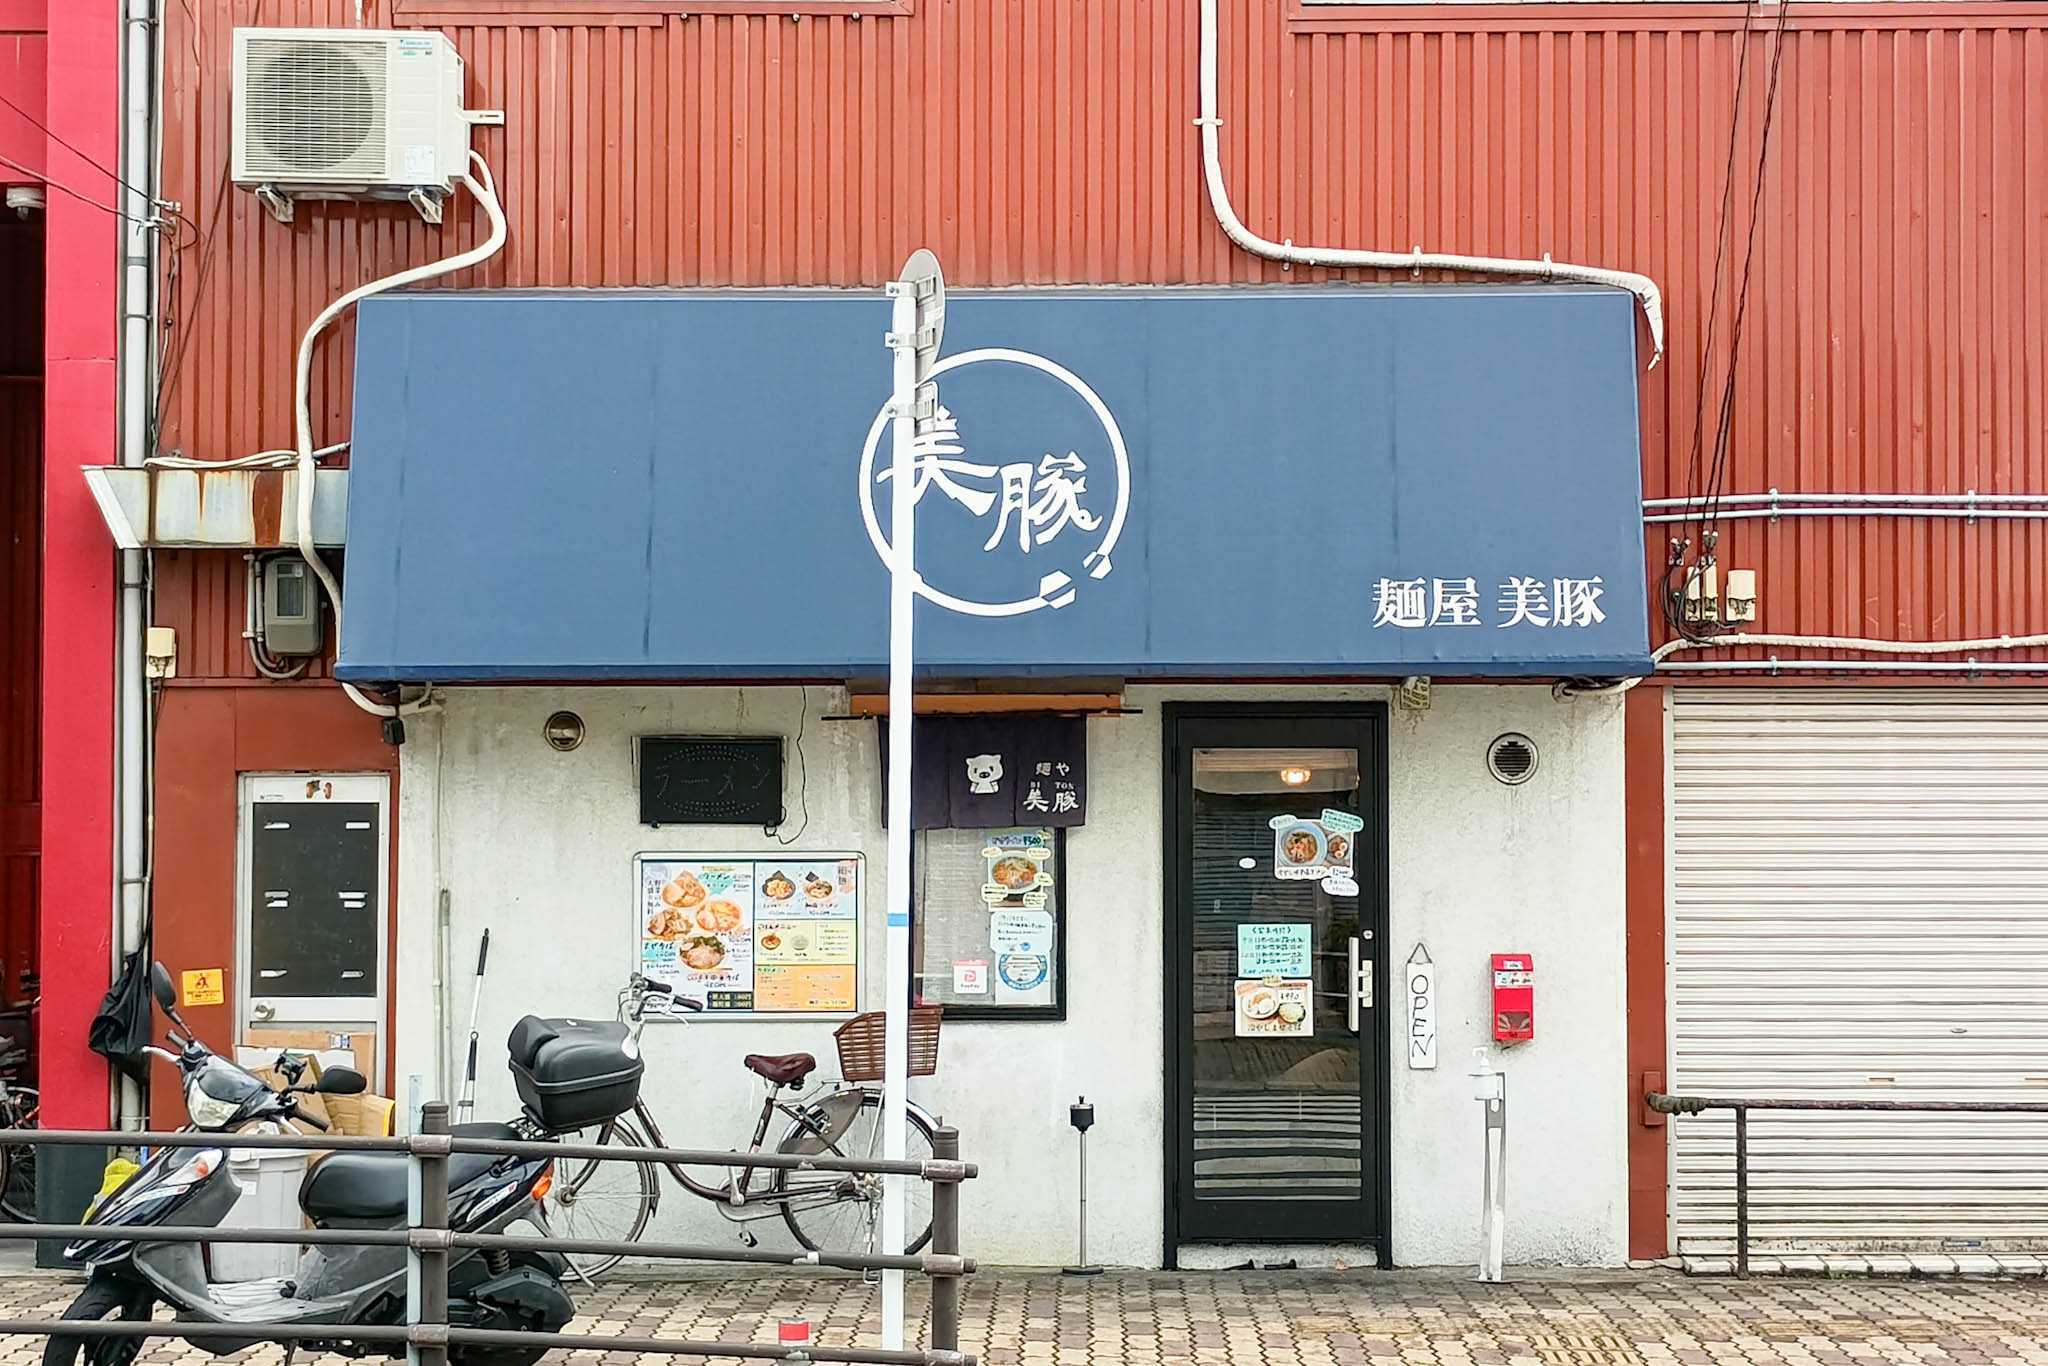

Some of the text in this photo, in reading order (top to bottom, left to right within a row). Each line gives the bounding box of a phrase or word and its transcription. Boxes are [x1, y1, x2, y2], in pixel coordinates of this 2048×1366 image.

[1372, 575, 1606, 628] 麺屋 美豚
[1023, 789, 1079, 813] 美豚
[1411, 974, 1434, 1058] OPEN
